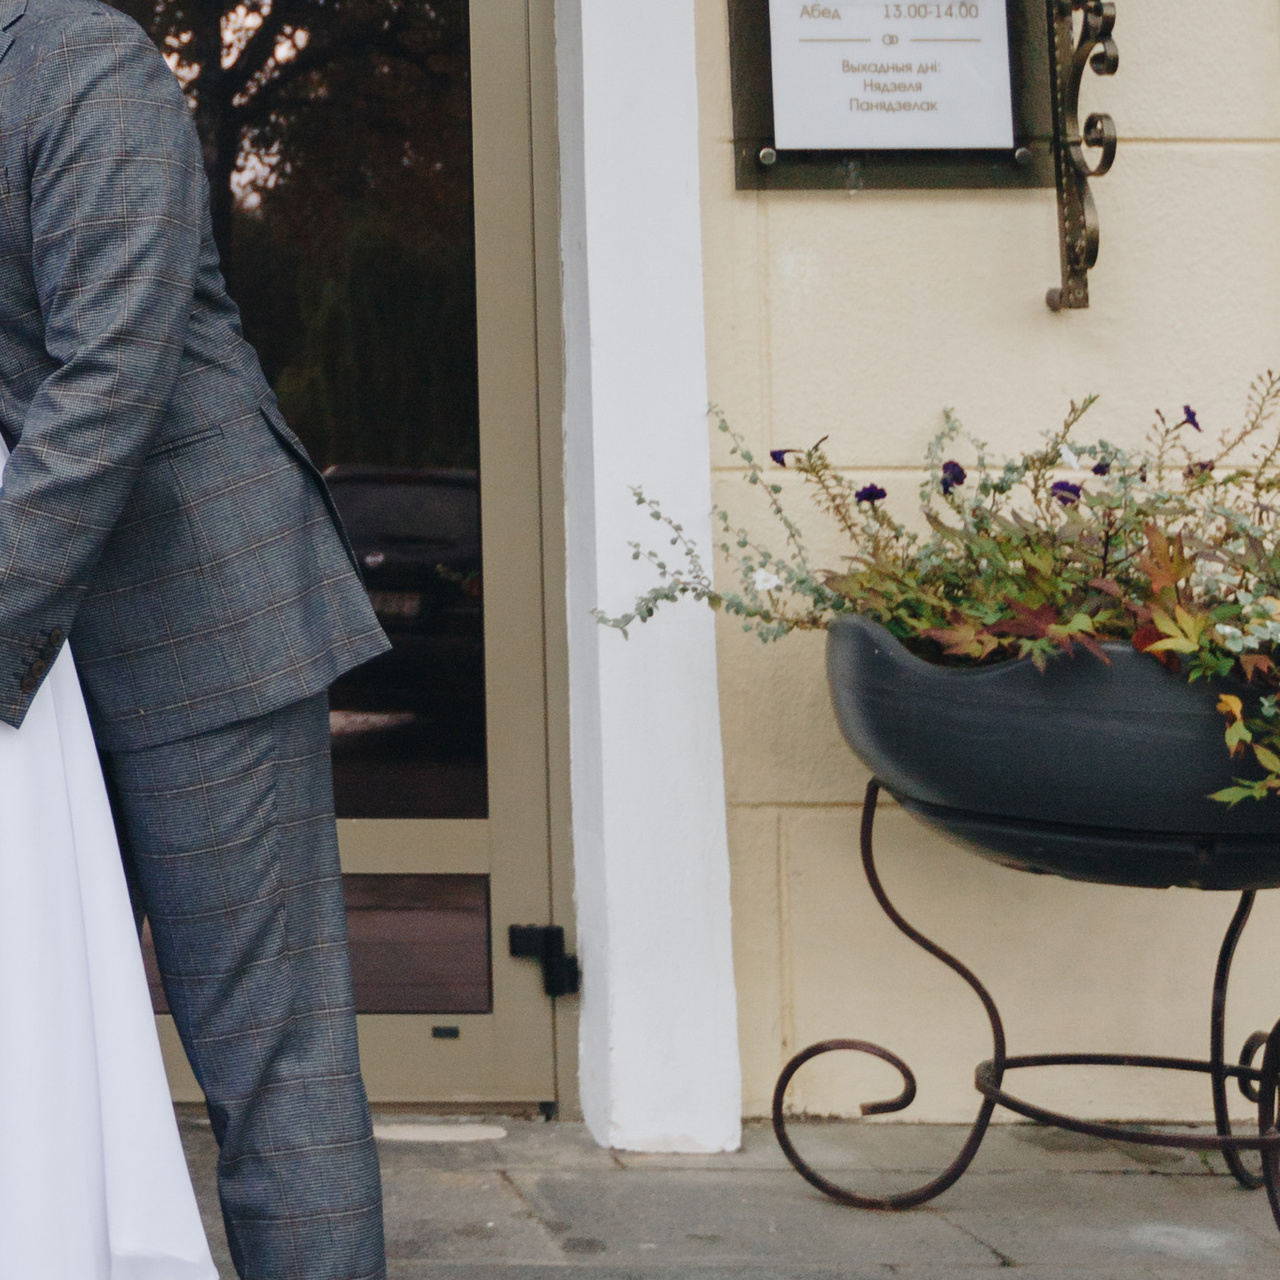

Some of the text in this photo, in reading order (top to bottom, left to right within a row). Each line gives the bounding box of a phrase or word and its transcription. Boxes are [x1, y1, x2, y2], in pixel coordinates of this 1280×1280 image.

[800, 3, 979, 20] Абед 13.00-14.00
[841, 59, 942, 75] Выхадныя дні:
[863, 78, 923, 93] Нядзеля
[849, 97, 939, 112] Панядзелак
